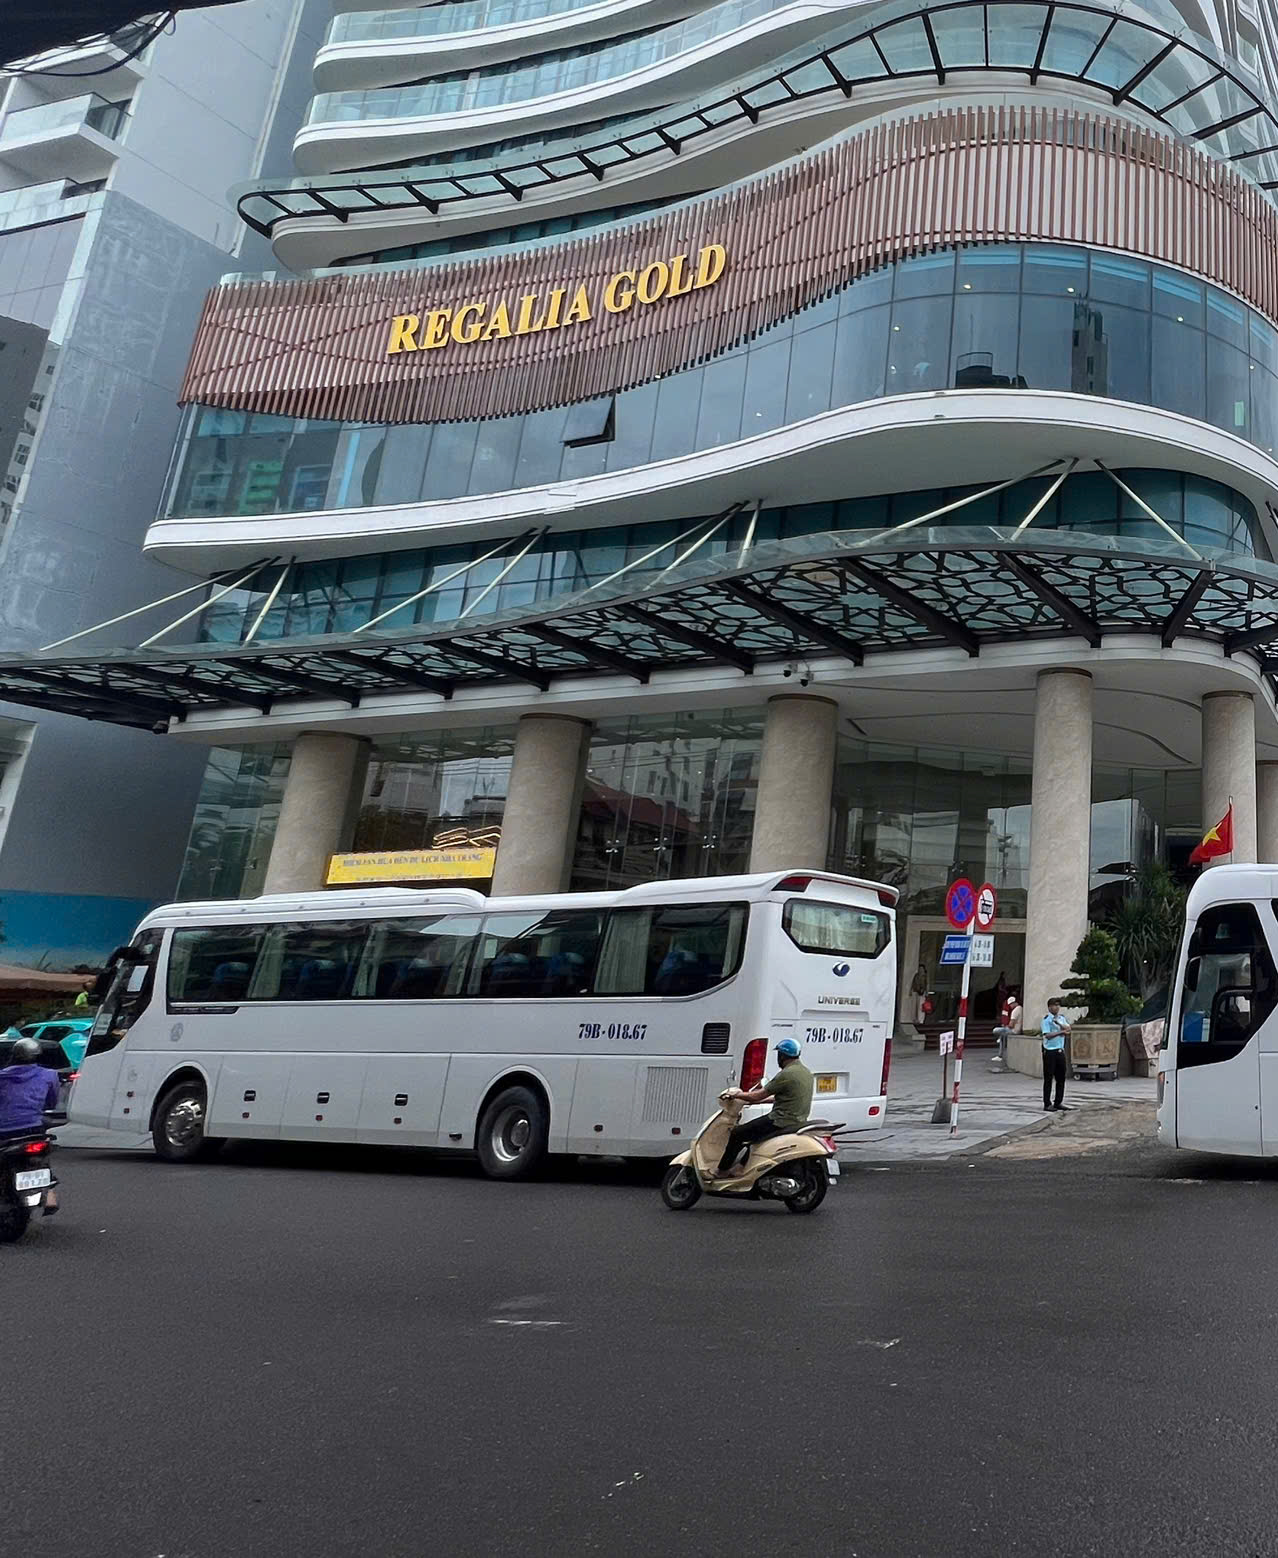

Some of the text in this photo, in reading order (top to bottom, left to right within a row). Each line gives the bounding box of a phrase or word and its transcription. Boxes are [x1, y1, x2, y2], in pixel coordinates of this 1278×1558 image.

[388, 244, 727, 355] REGALIA GOLD
[817, 995, 861, 1006] UNIVERSE
